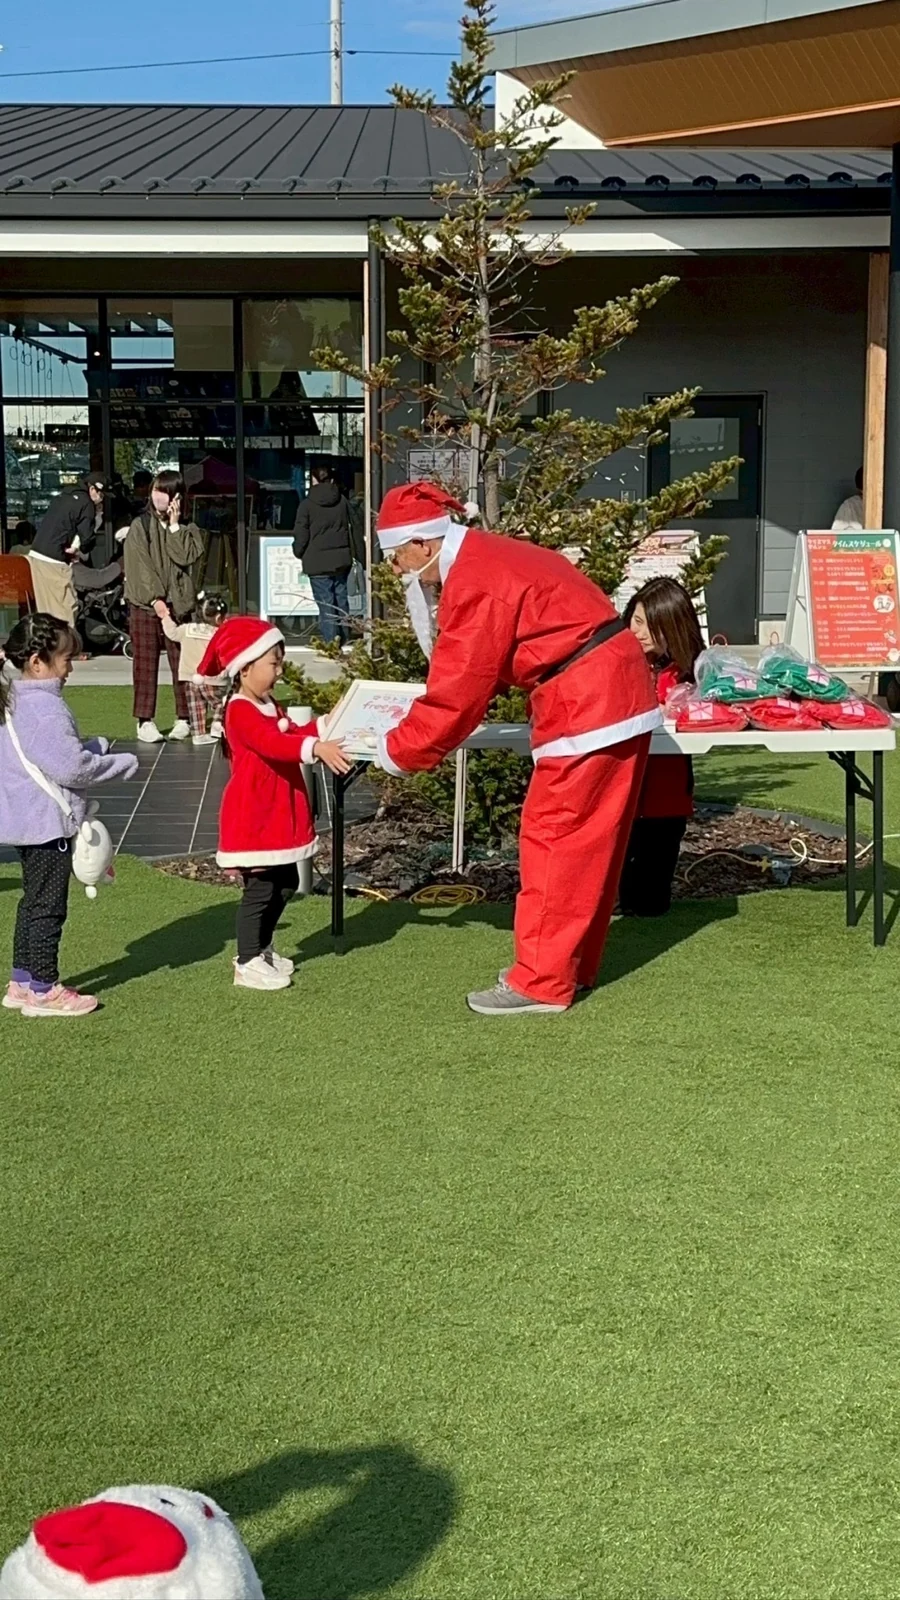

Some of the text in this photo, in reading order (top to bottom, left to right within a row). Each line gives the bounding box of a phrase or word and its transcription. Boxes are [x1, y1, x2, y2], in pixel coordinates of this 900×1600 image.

[832, 540, 882, 548] タイムスケジュール
